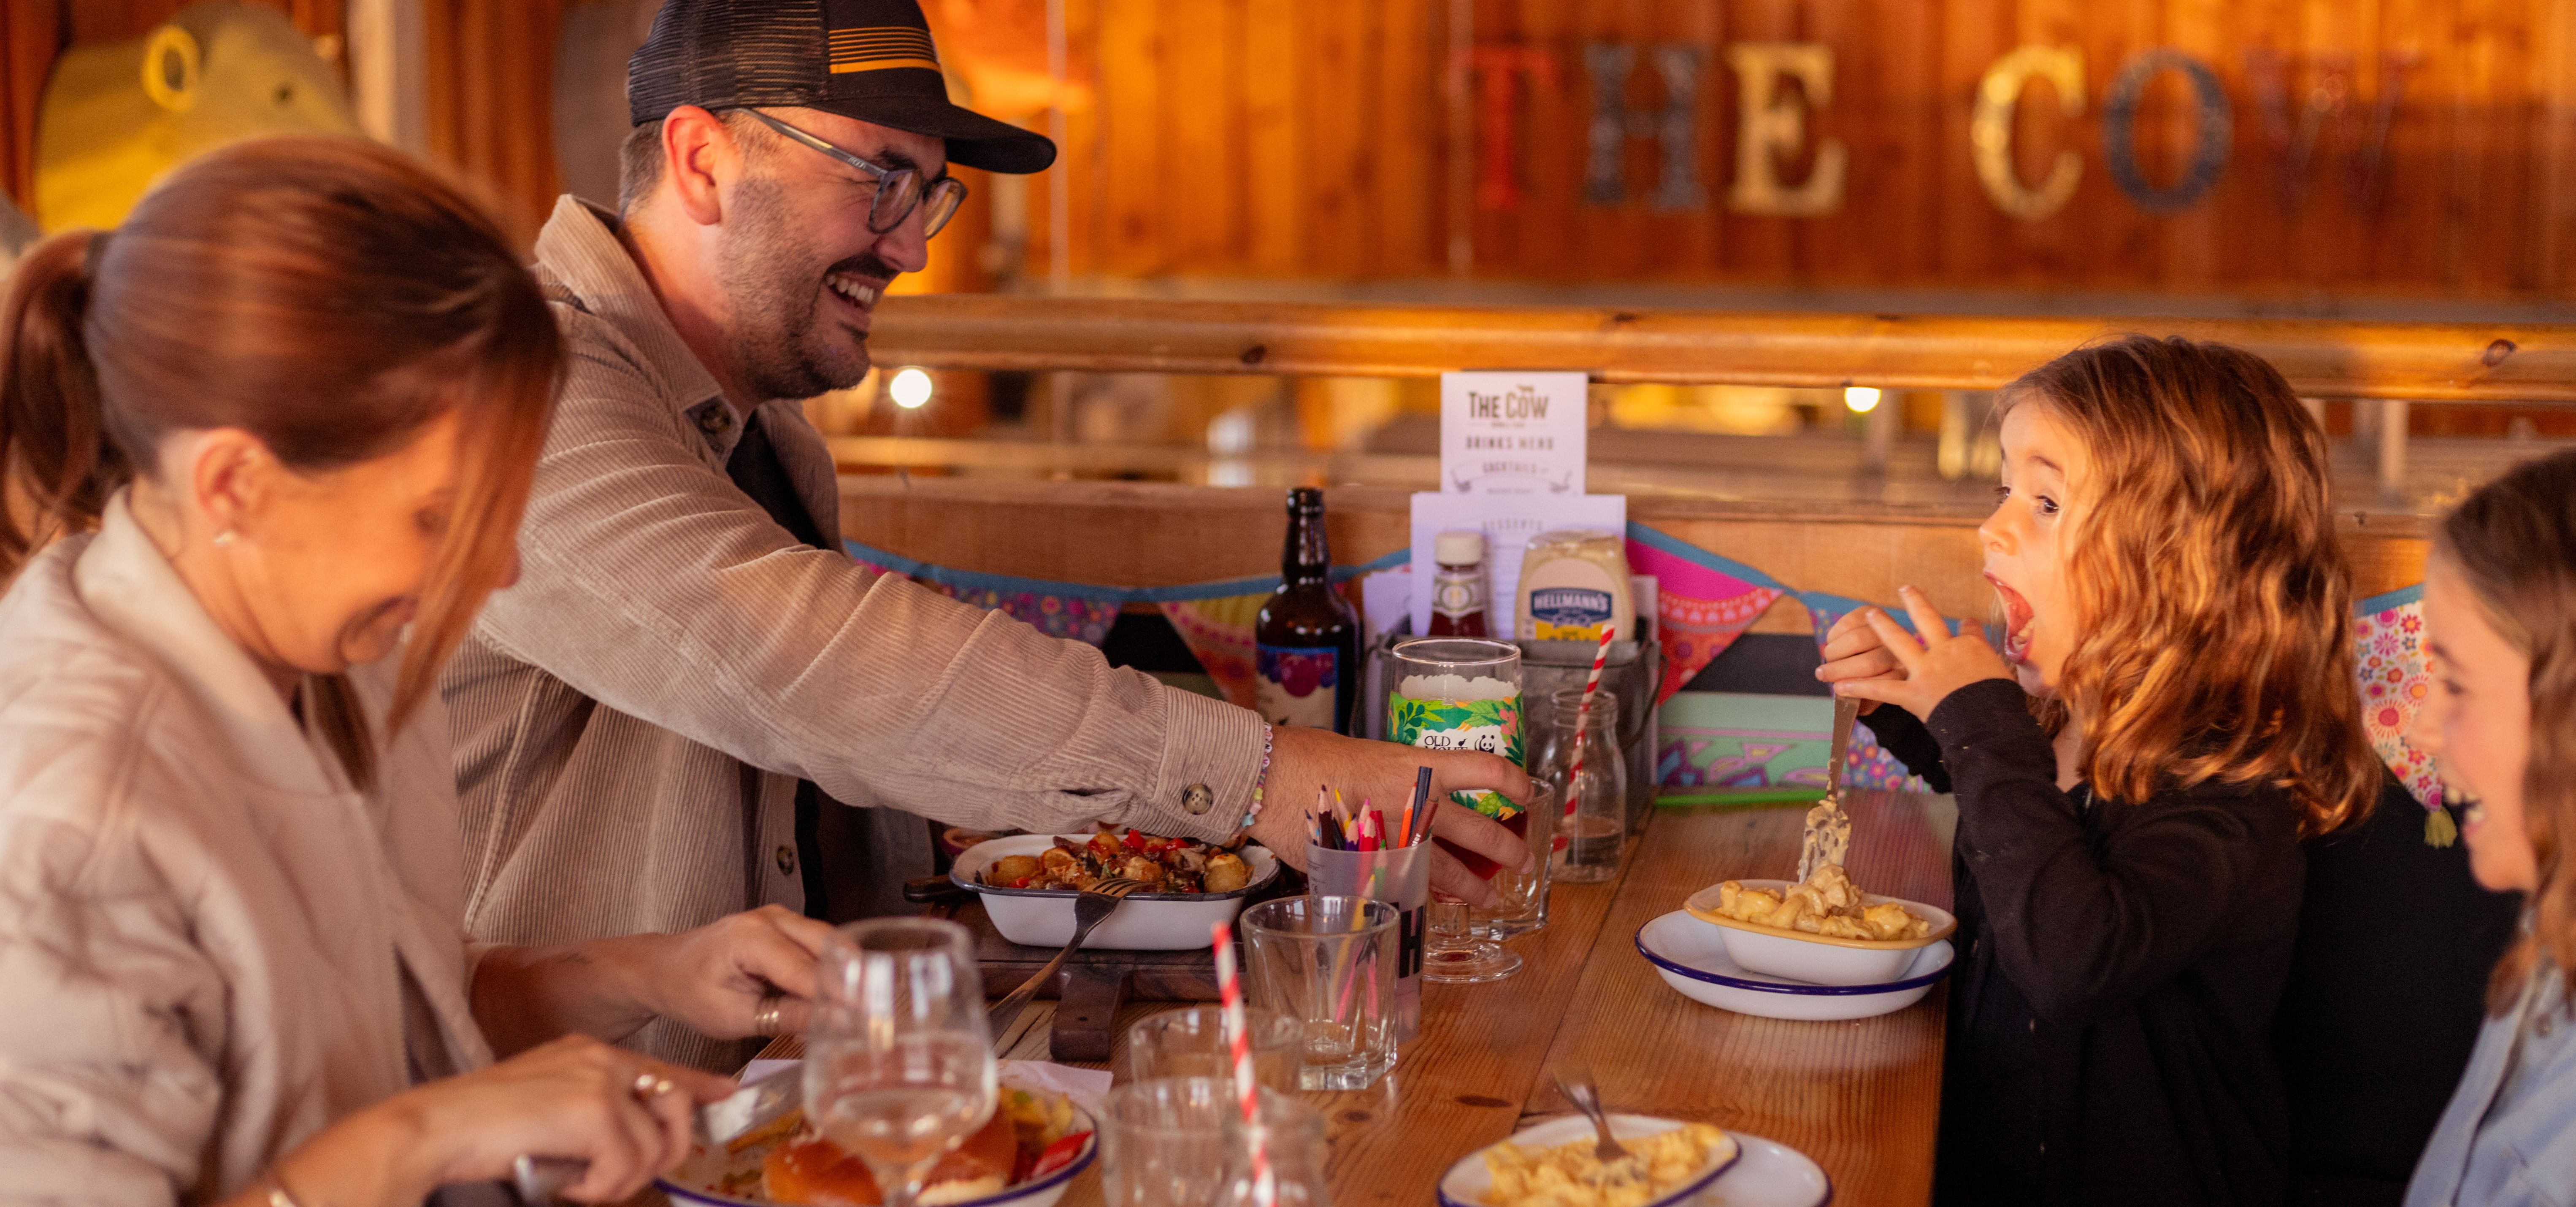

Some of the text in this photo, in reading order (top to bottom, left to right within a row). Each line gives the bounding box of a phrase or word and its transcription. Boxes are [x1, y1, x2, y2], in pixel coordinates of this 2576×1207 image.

[1448, 41, 2422, 220] THE COW
[1534, 592, 1609, 612] HELLMANN'S
[1424, 735, 1451, 747] OLD
